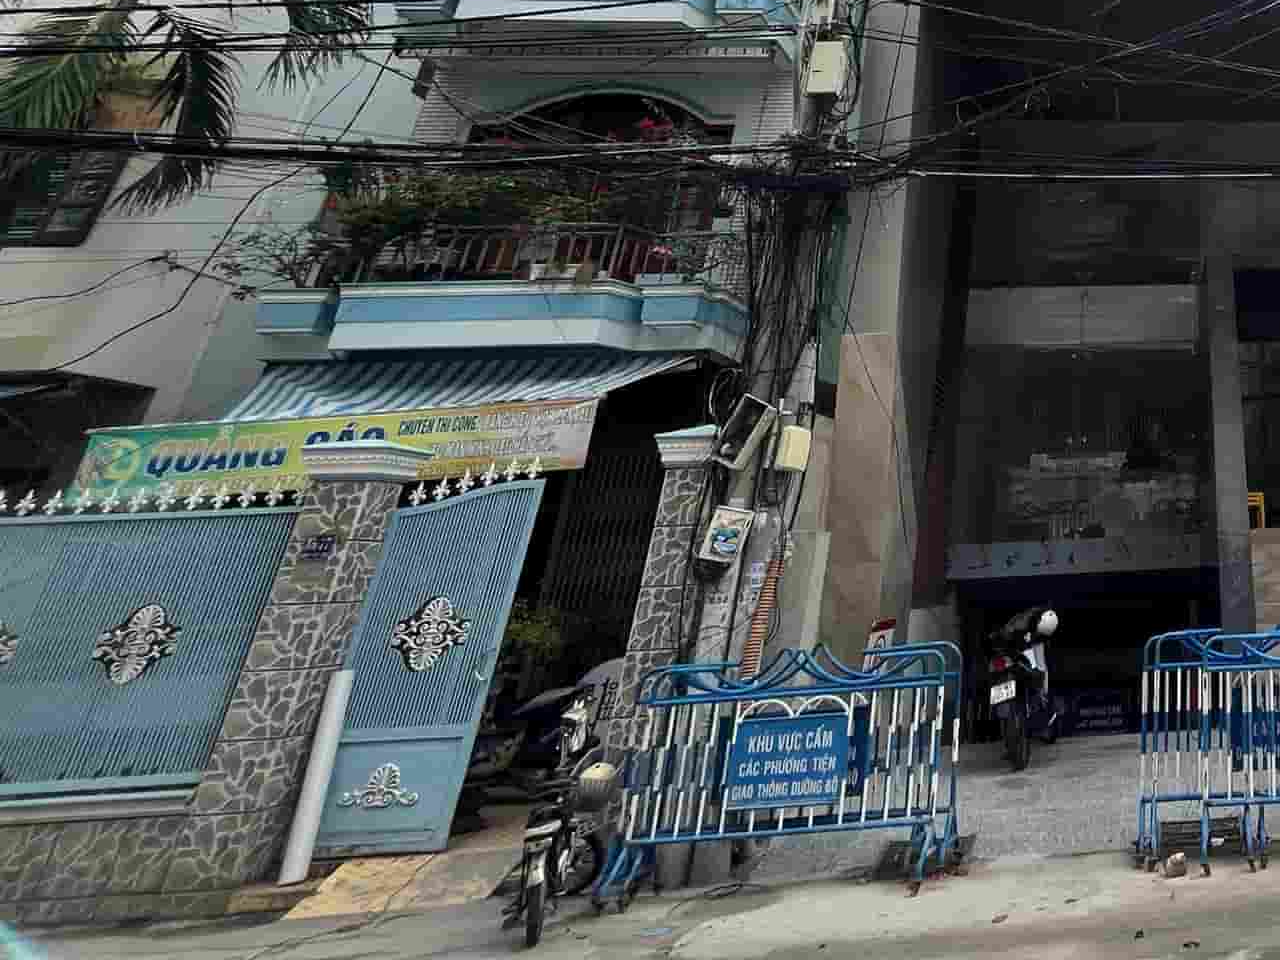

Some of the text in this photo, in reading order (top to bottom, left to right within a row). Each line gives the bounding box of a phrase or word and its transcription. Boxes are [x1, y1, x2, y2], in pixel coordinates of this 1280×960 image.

[144, 425, 287, 478] QUẢNG
[747, 724, 833, 754] KHU VỰC CẤM
[739, 758, 760, 777] CÁC
[764, 755, 808, 775] PHƯƠNG
[813, 753, 836, 774] TIỆN
